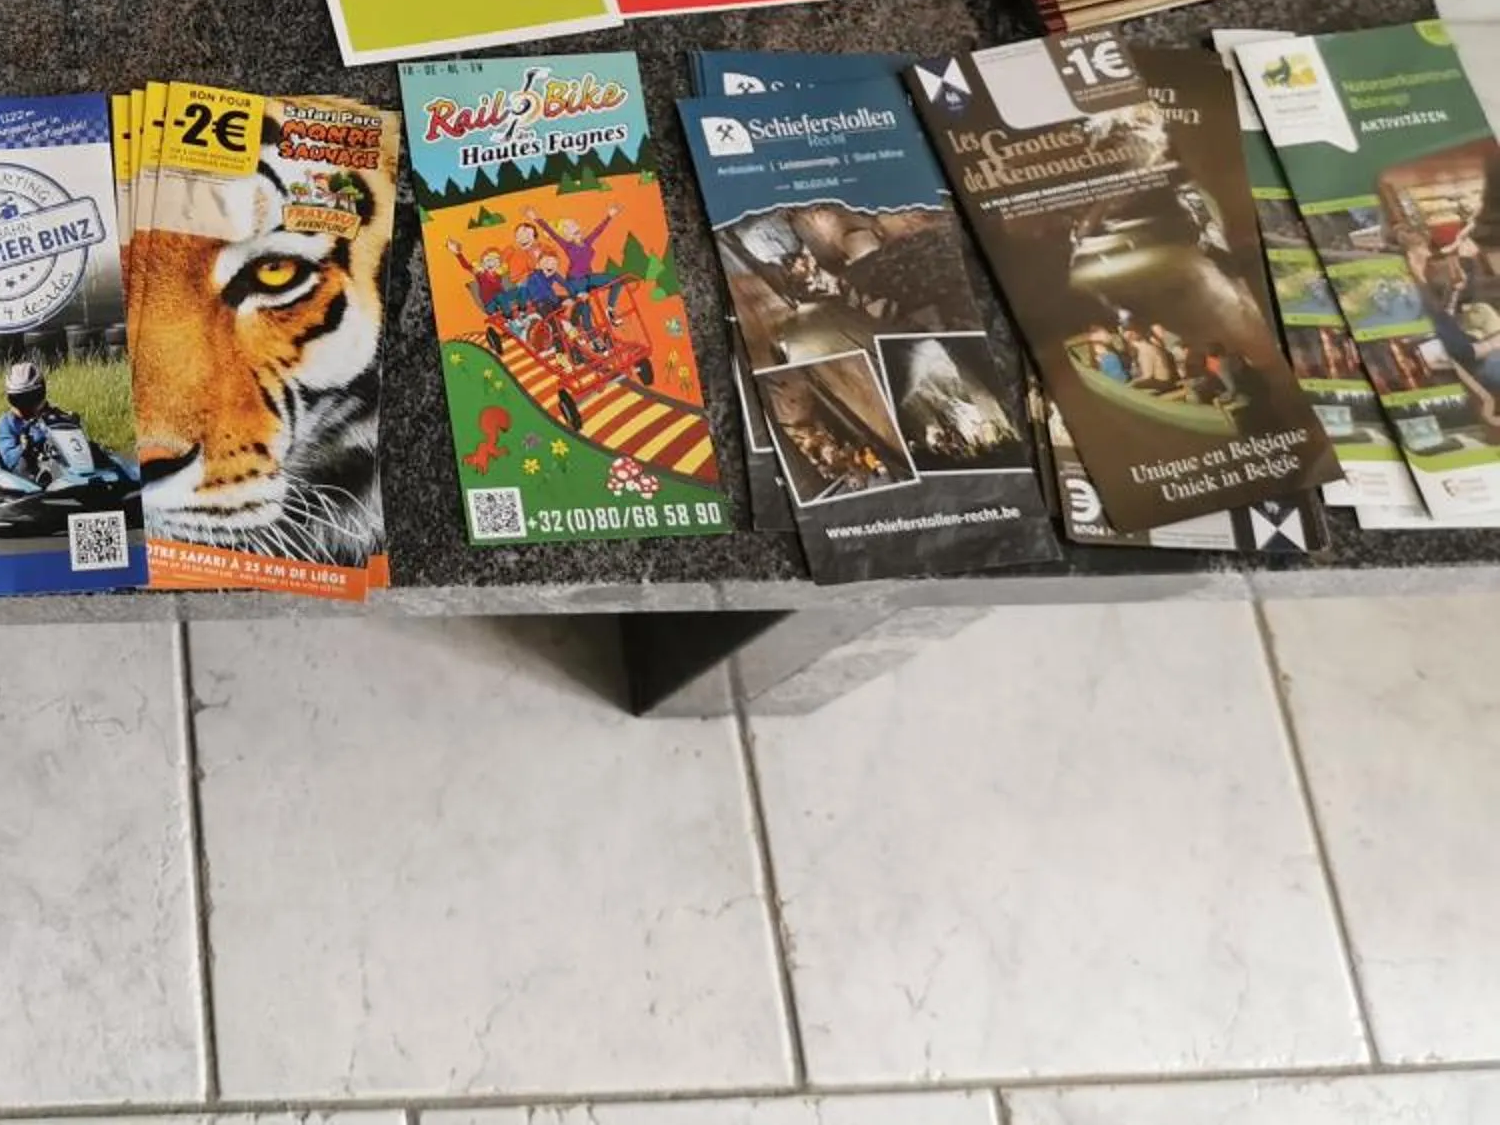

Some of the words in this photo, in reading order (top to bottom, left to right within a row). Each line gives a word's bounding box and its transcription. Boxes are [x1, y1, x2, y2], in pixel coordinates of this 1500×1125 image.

[189, 89, 216, 102] BON
[218, 94, 253, 109] POUR
[426, 90, 510, 141] Rail
[543, 73, 627, 118] Bike
[173, 103, 251, 154] -2€
[283, 105, 336, 123] Safari
[338, 111, 383, 127] Parc
[750, 107, 896, 140] Schieferstollen
[1360, 110, 1449, 133] AKTIVITÄTEN
[281, 120, 382, 149] MONDE
[461, 138, 541, 167] Hautes
[549, 125, 626, 154] Fagnes
[947, 129, 981, 155] Les
[980, 125, 1085, 163] Grottes
[278, 141, 379, 170] SAUVAGE
[963, 167, 987, 194] de
[39, 218, 94, 252] BINZ
[1130, 456, 1200, 485] Unique
[1202, 448, 1225, 467] en
[1229, 427, 1308, 459] Belgique
[1160, 476, 1216, 502] Uniek
[1222, 470, 1241, 485] in
[665, 503, 690, 525] 58
[697, 502, 722, 525] 90
[825, 505, 1021, 540] www.schieferstollen-recht.be
[179, 550, 227, 568] SAFARI
[264, 563, 286, 577] KM
[289, 567, 307, 581] DE
[311, 569, 348, 585] LIÈGE
